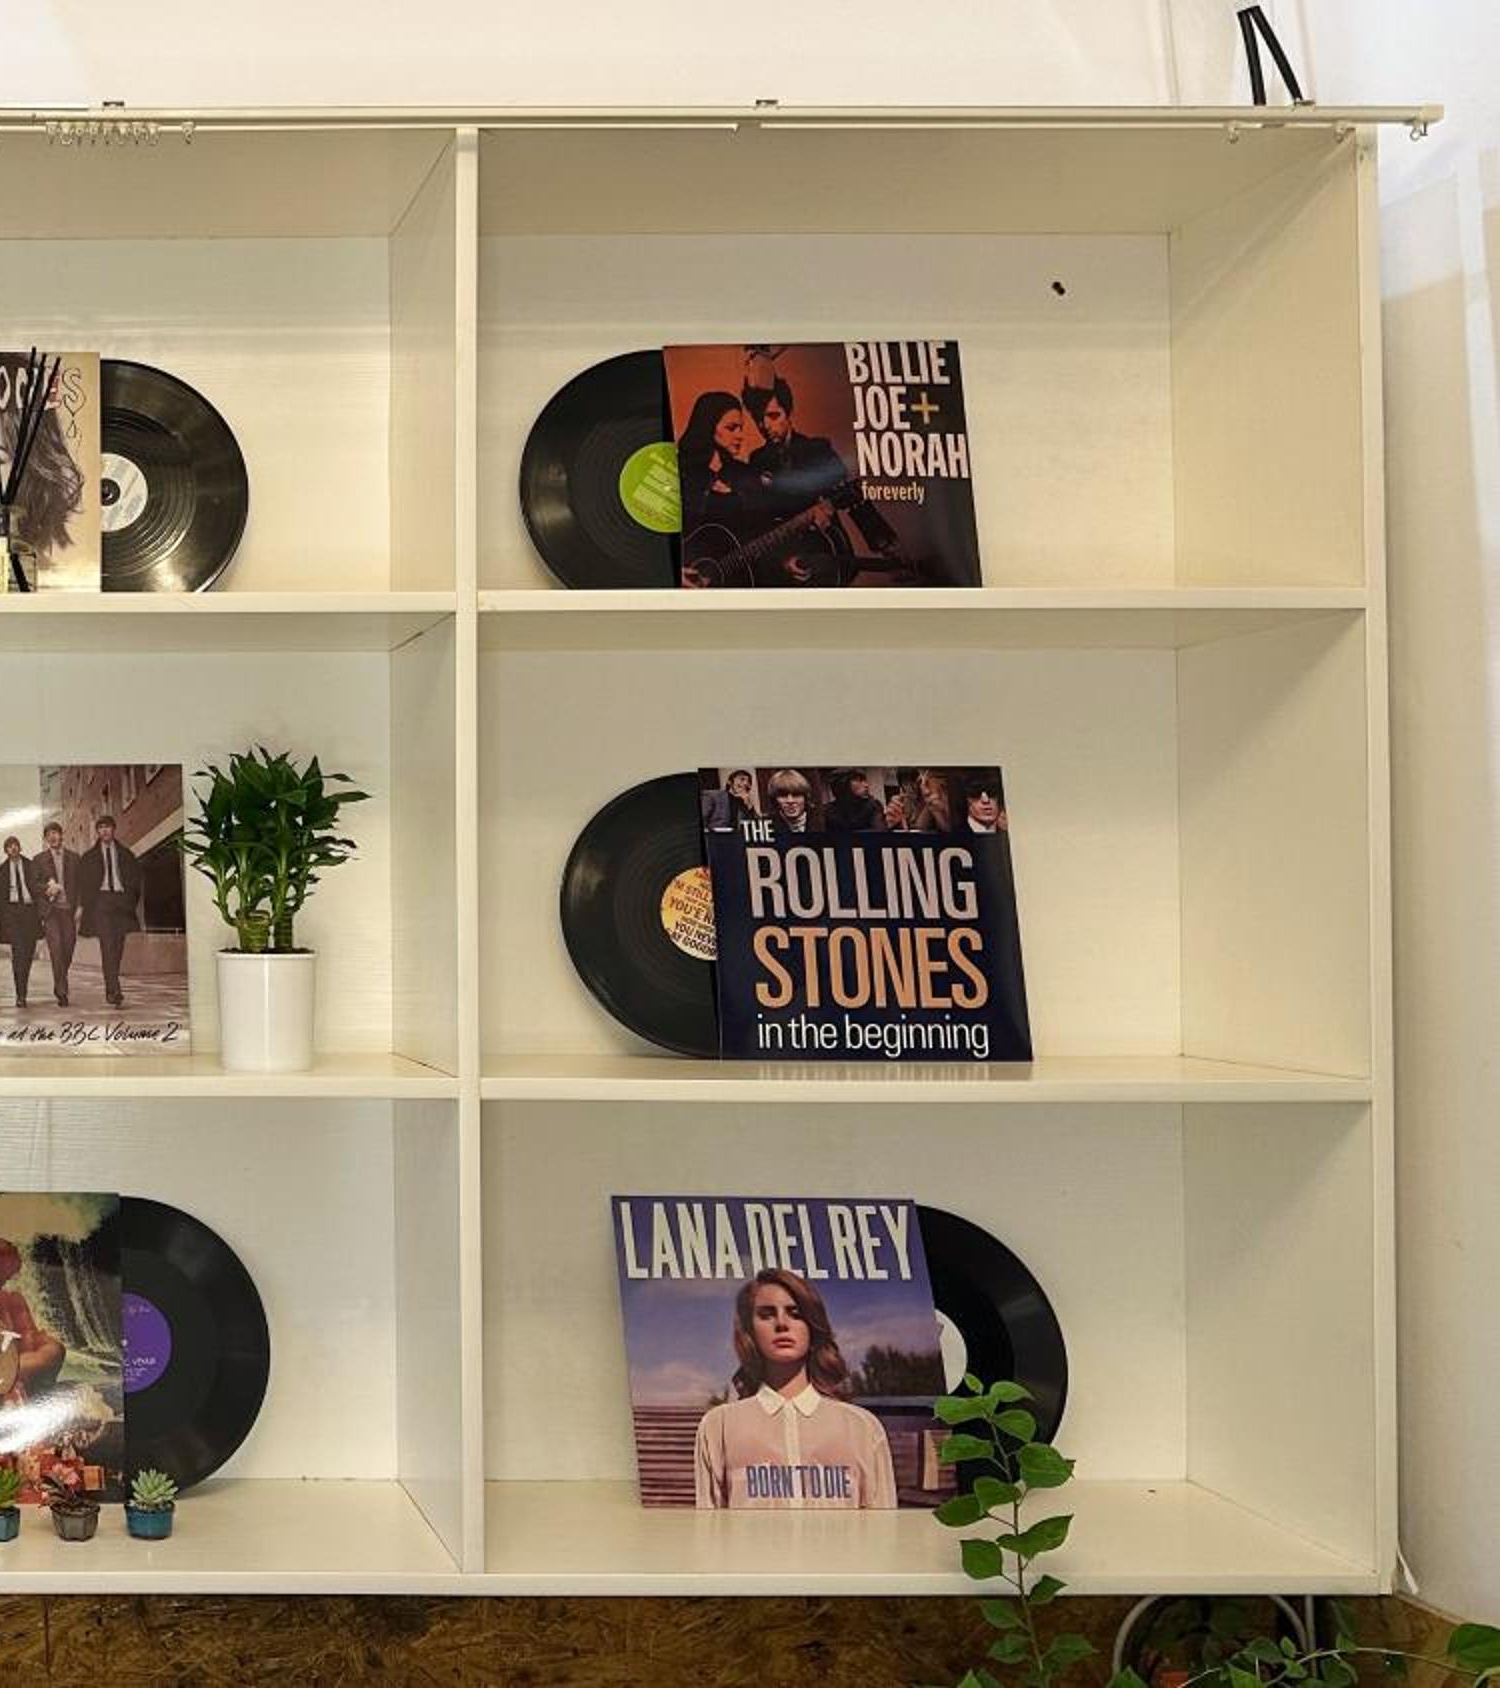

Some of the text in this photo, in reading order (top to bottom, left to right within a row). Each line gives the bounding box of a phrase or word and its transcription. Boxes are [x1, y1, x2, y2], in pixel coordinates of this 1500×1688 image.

[844, 341, 951, 385] BILLIE
[855, 431, 971, 479] NORAH
[861, 480, 925, 505] foreverly
[740, 819, 776, 843] THE
[746, 847, 980, 920] ROLLING
[753, 925, 990, 1010] STONES
[29, 1026, 55, 1041] the
[59, 1020, 101, 1047] BBC
[104, 1021, 160, 1042] Volume
[757, 1013, 990, 1058] in the beginning
[620, 1201, 912, 1281] LANA DEL REY
[745, 1465, 853, 1499] BORN TO DIE
